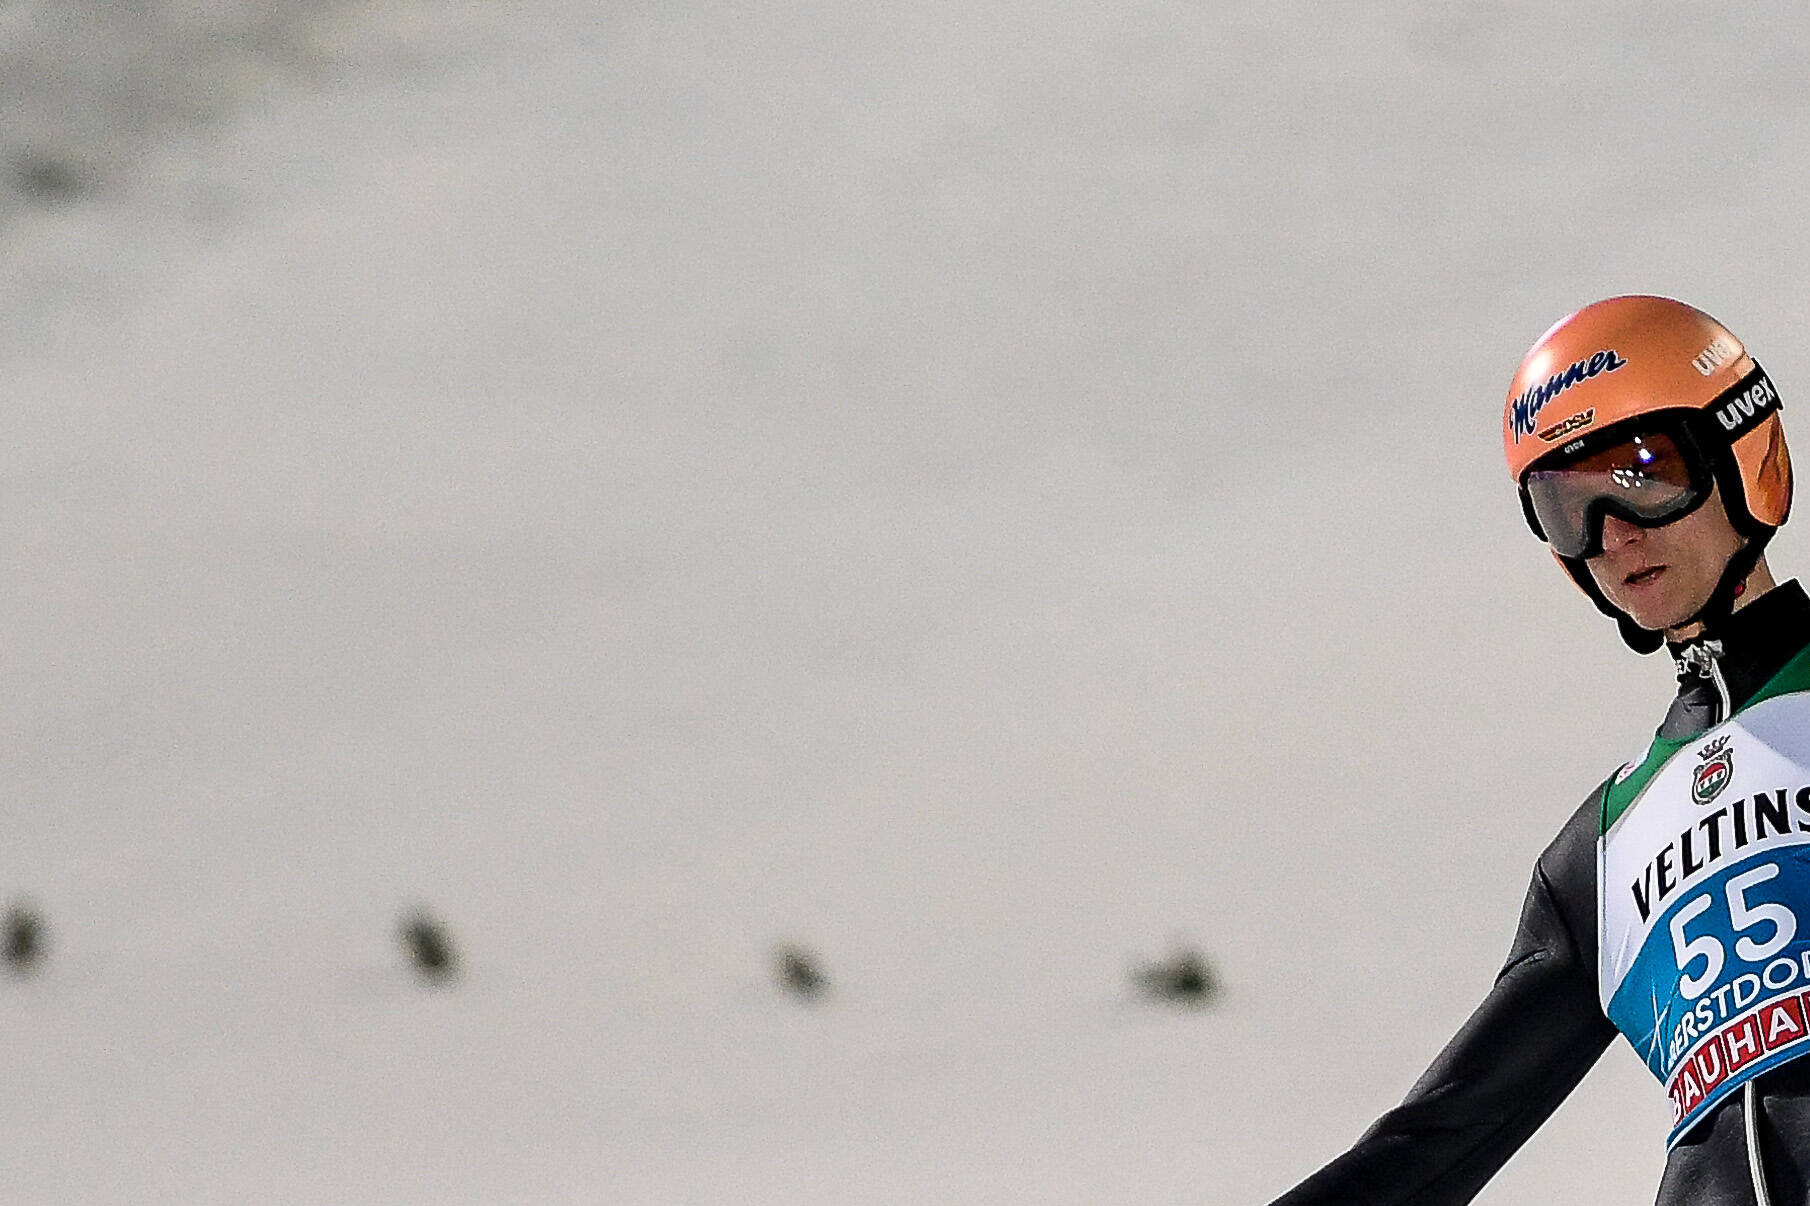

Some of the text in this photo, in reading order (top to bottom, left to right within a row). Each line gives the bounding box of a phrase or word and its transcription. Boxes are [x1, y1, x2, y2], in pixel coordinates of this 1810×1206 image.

[1508, 349, 1629, 446] Manner
[1715, 376, 1776, 430] uvex
[1669, 862, 1797, 1001] 55
